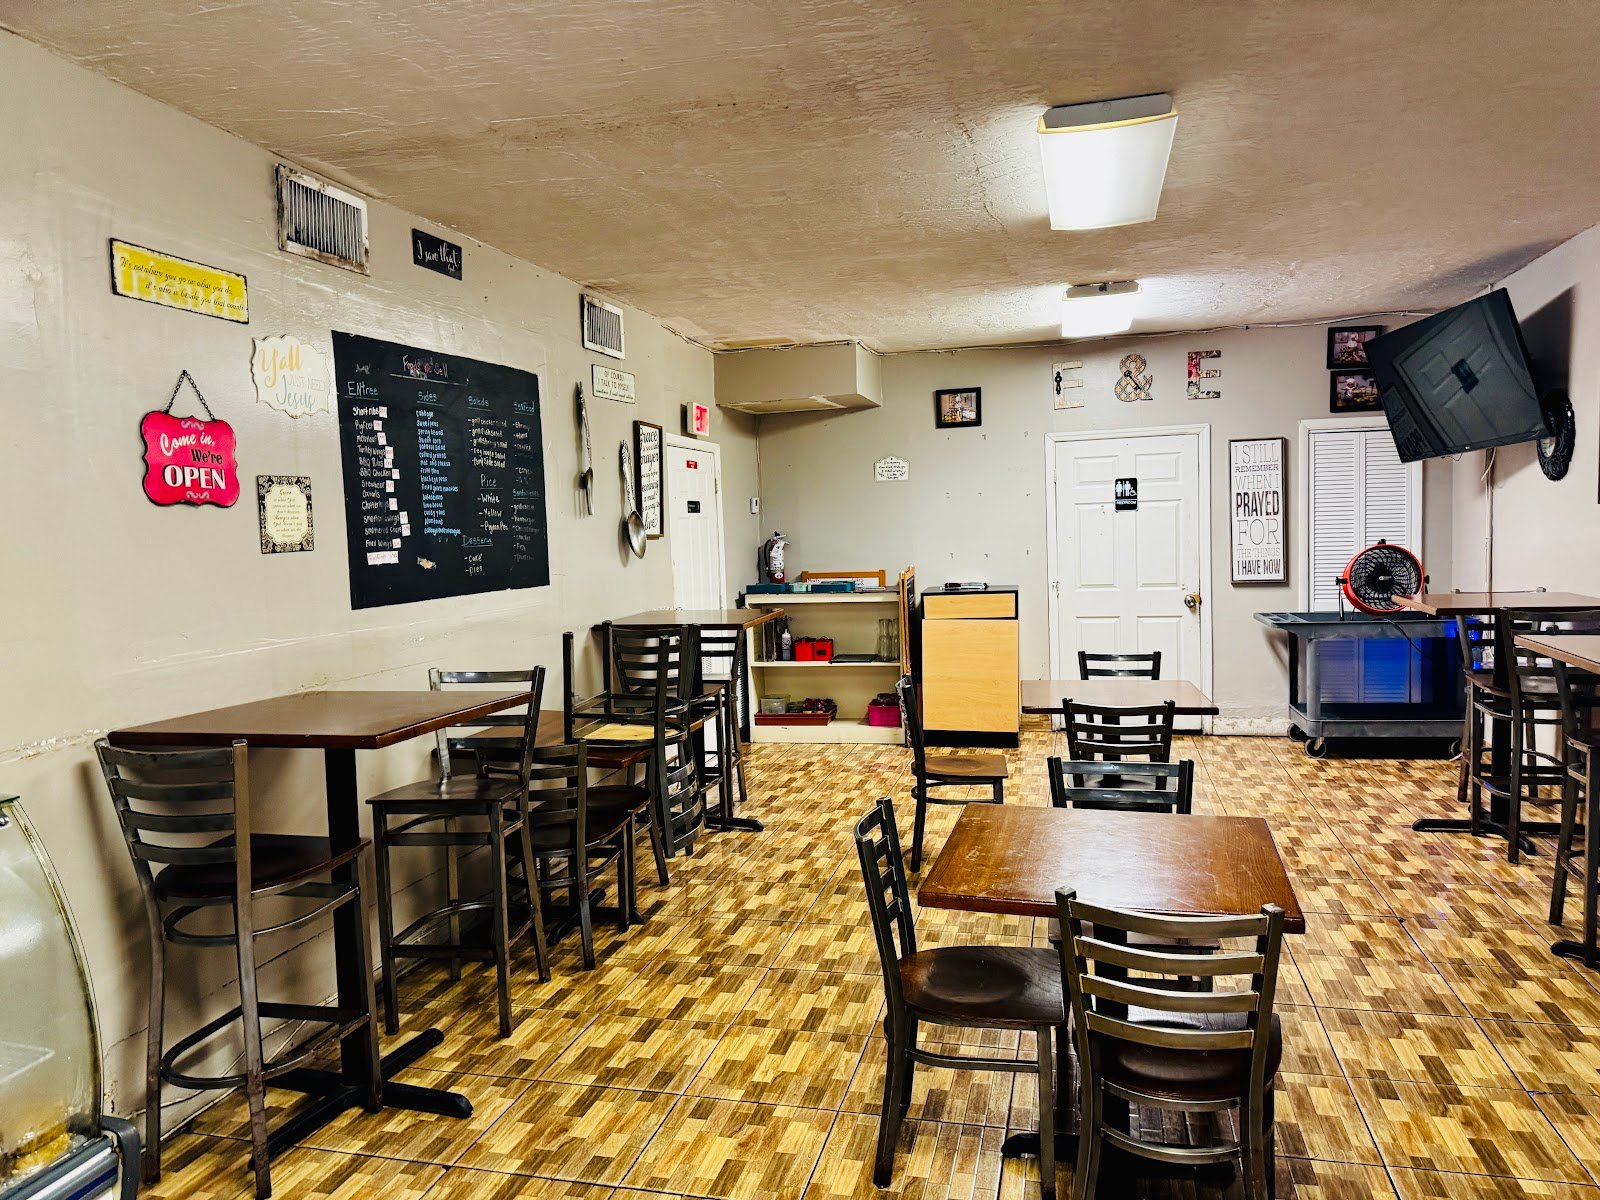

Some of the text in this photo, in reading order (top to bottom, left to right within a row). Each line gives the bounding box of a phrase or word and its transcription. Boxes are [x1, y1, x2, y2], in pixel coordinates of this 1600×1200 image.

[165, 273, 177, 282] you
[213, 286, 224, 295] you
[1187, 350, 1222, 400] E
[160, 433, 197, 457] Come
[1234, 443, 1279, 465] I STILL
[191, 449, 223, 465] We're
[359, 457, 371, 468] BBQ
[164, 464, 226, 490] OPEN
[1235, 464, 1280, 473] REMEMBER
[1235, 474, 1280, 490] WHEN I
[1236, 490, 1281, 517] PRAYED
[1237, 518, 1281, 546] FOR
[1241, 560, 1262, 575] HAVE
[1263, 559, 1281, 575] NOW
